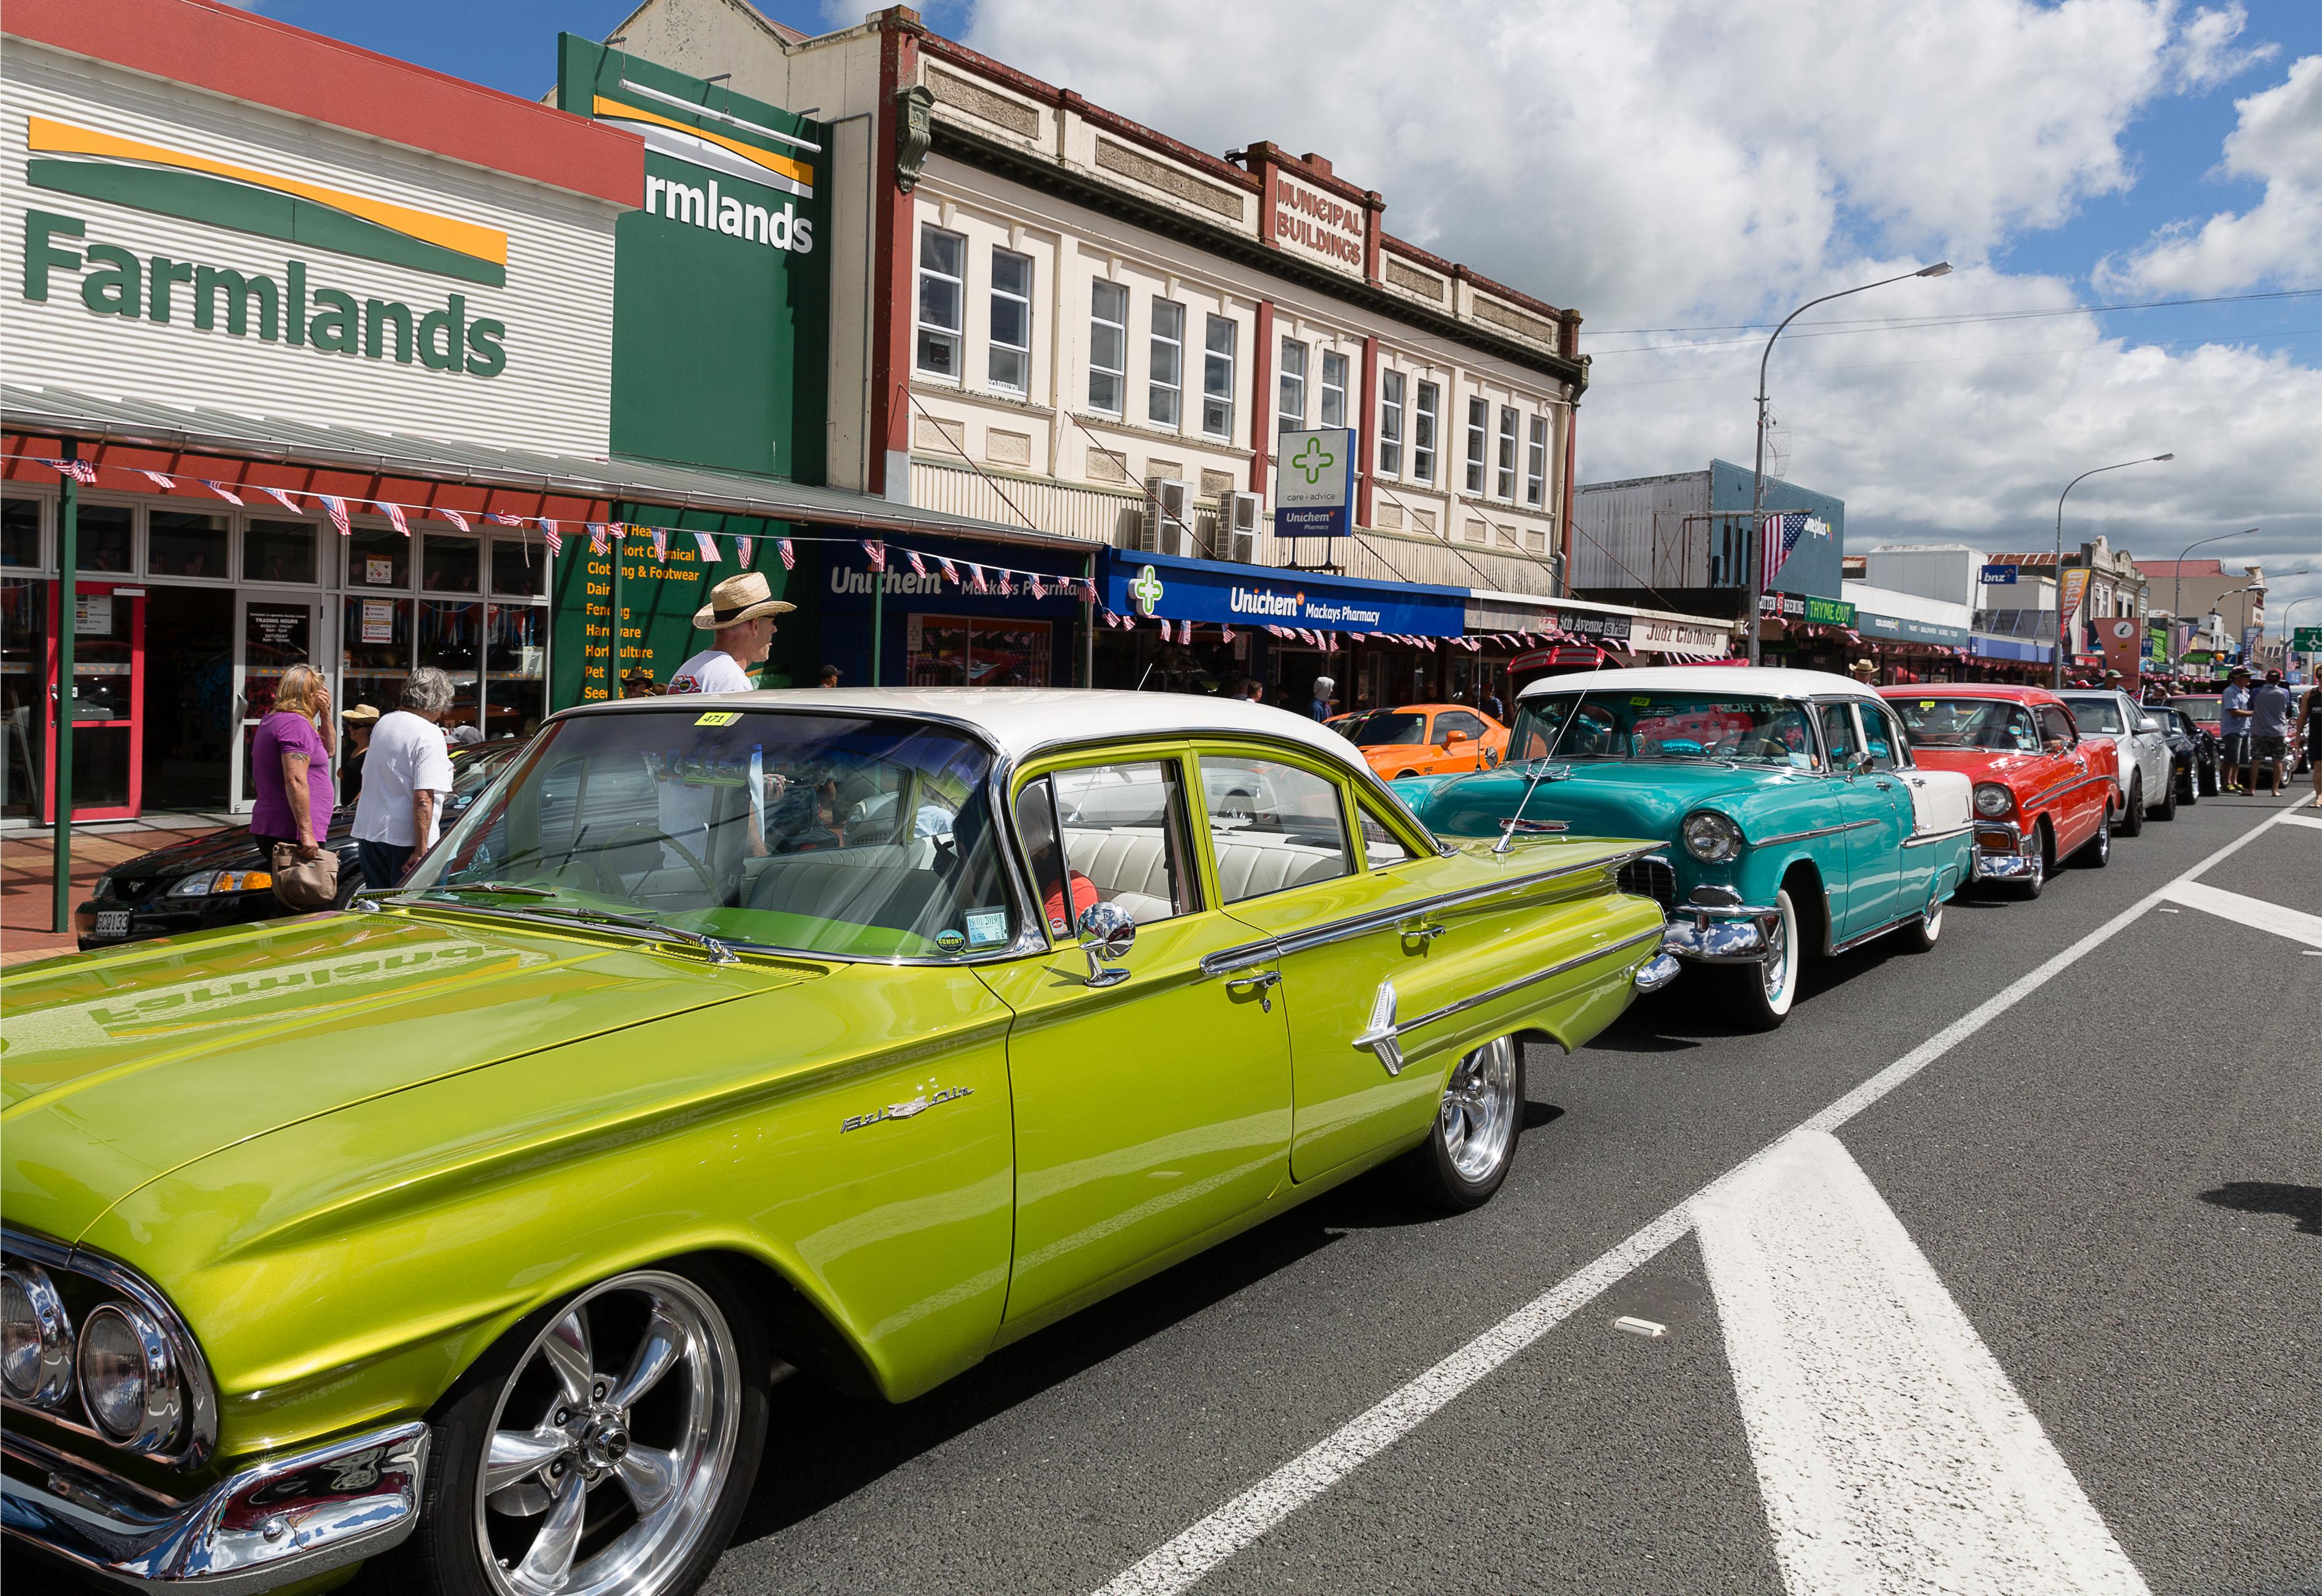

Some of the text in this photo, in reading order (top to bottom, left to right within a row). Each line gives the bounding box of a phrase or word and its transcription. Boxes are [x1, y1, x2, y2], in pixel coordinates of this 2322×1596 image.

[645, 176, 812, 254] rmlands
[1278, 179, 1362, 237] MUNICIPAL
[1277, 211, 1361, 266] BUILDINGS
[24, 208, 506, 377] Farmlands
[1286, 512, 1330, 522] Unichem
[632, 524, 652, 538] Hea
[587, 562, 699, 581] Clotng & Footwear
[831, 564, 941, 594] Unihem
[1022, 580, 1080, 597] Parma
[1984, 572, 2006, 582] bnz
[587, 582, 610, 595] Dair
[586, 603, 630, 620] Feng
[1230, 587, 1380, 626] Unichem Mackays Pharmacy
[1810, 601, 1851, 622] THYME OUT
[586, 624, 641, 638] Harare
[1559, 614, 1573, 630] 5th
[1574, 616, 1604, 633] Avenue
[1606, 621, 1612, 634] is
[1613, 618, 1628, 635] Hair
[1647, 624, 1717, 648] Judz Clothing
[586, 645, 654, 659] Hortulture
[585, 665, 605, 678] Pet
[97, 913, 128, 930] GCQ133
[841, 1086, 975, 1134] Bel Air
